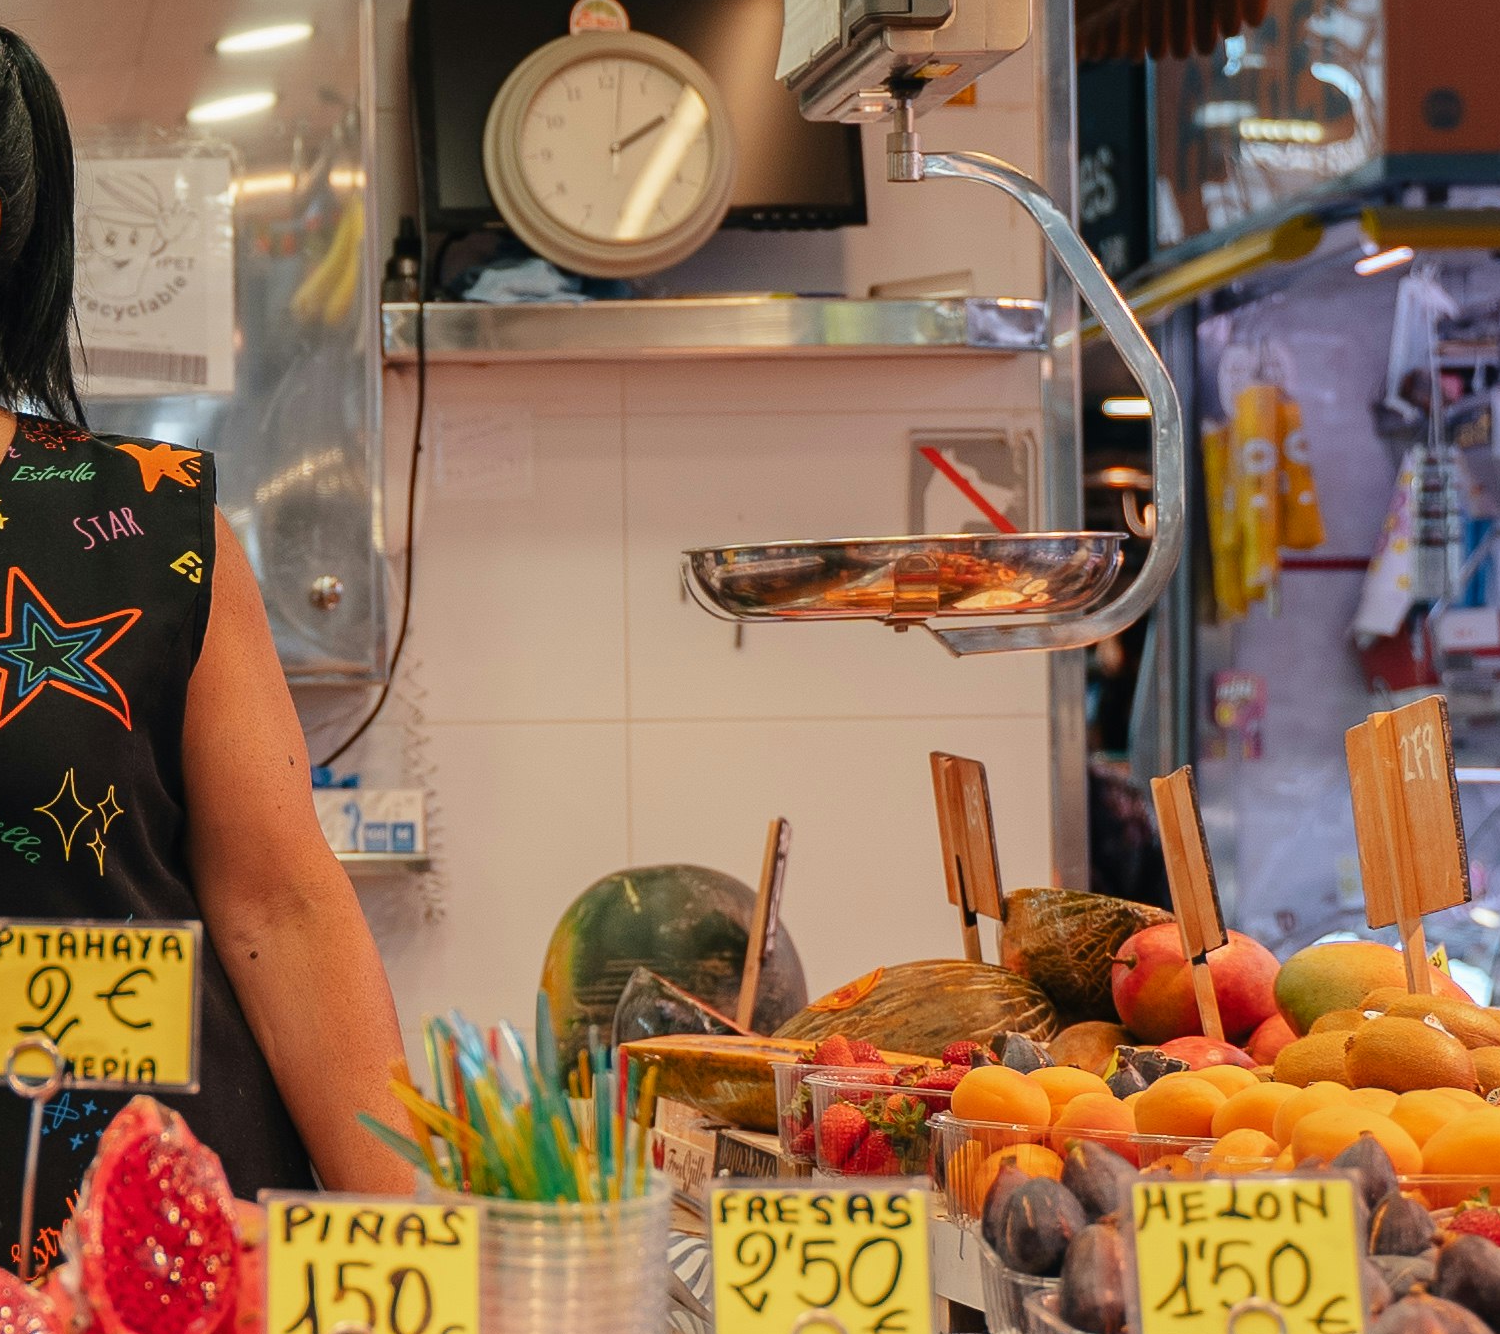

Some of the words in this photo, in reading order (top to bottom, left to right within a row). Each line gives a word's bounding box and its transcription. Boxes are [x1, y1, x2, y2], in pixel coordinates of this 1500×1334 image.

[79, 275, 187, 323] recyclable
[11, 462, 97, 483] Estrella
[72, 506, 145, 551] STAR
[719, 1192, 913, 1230] FRESAS
